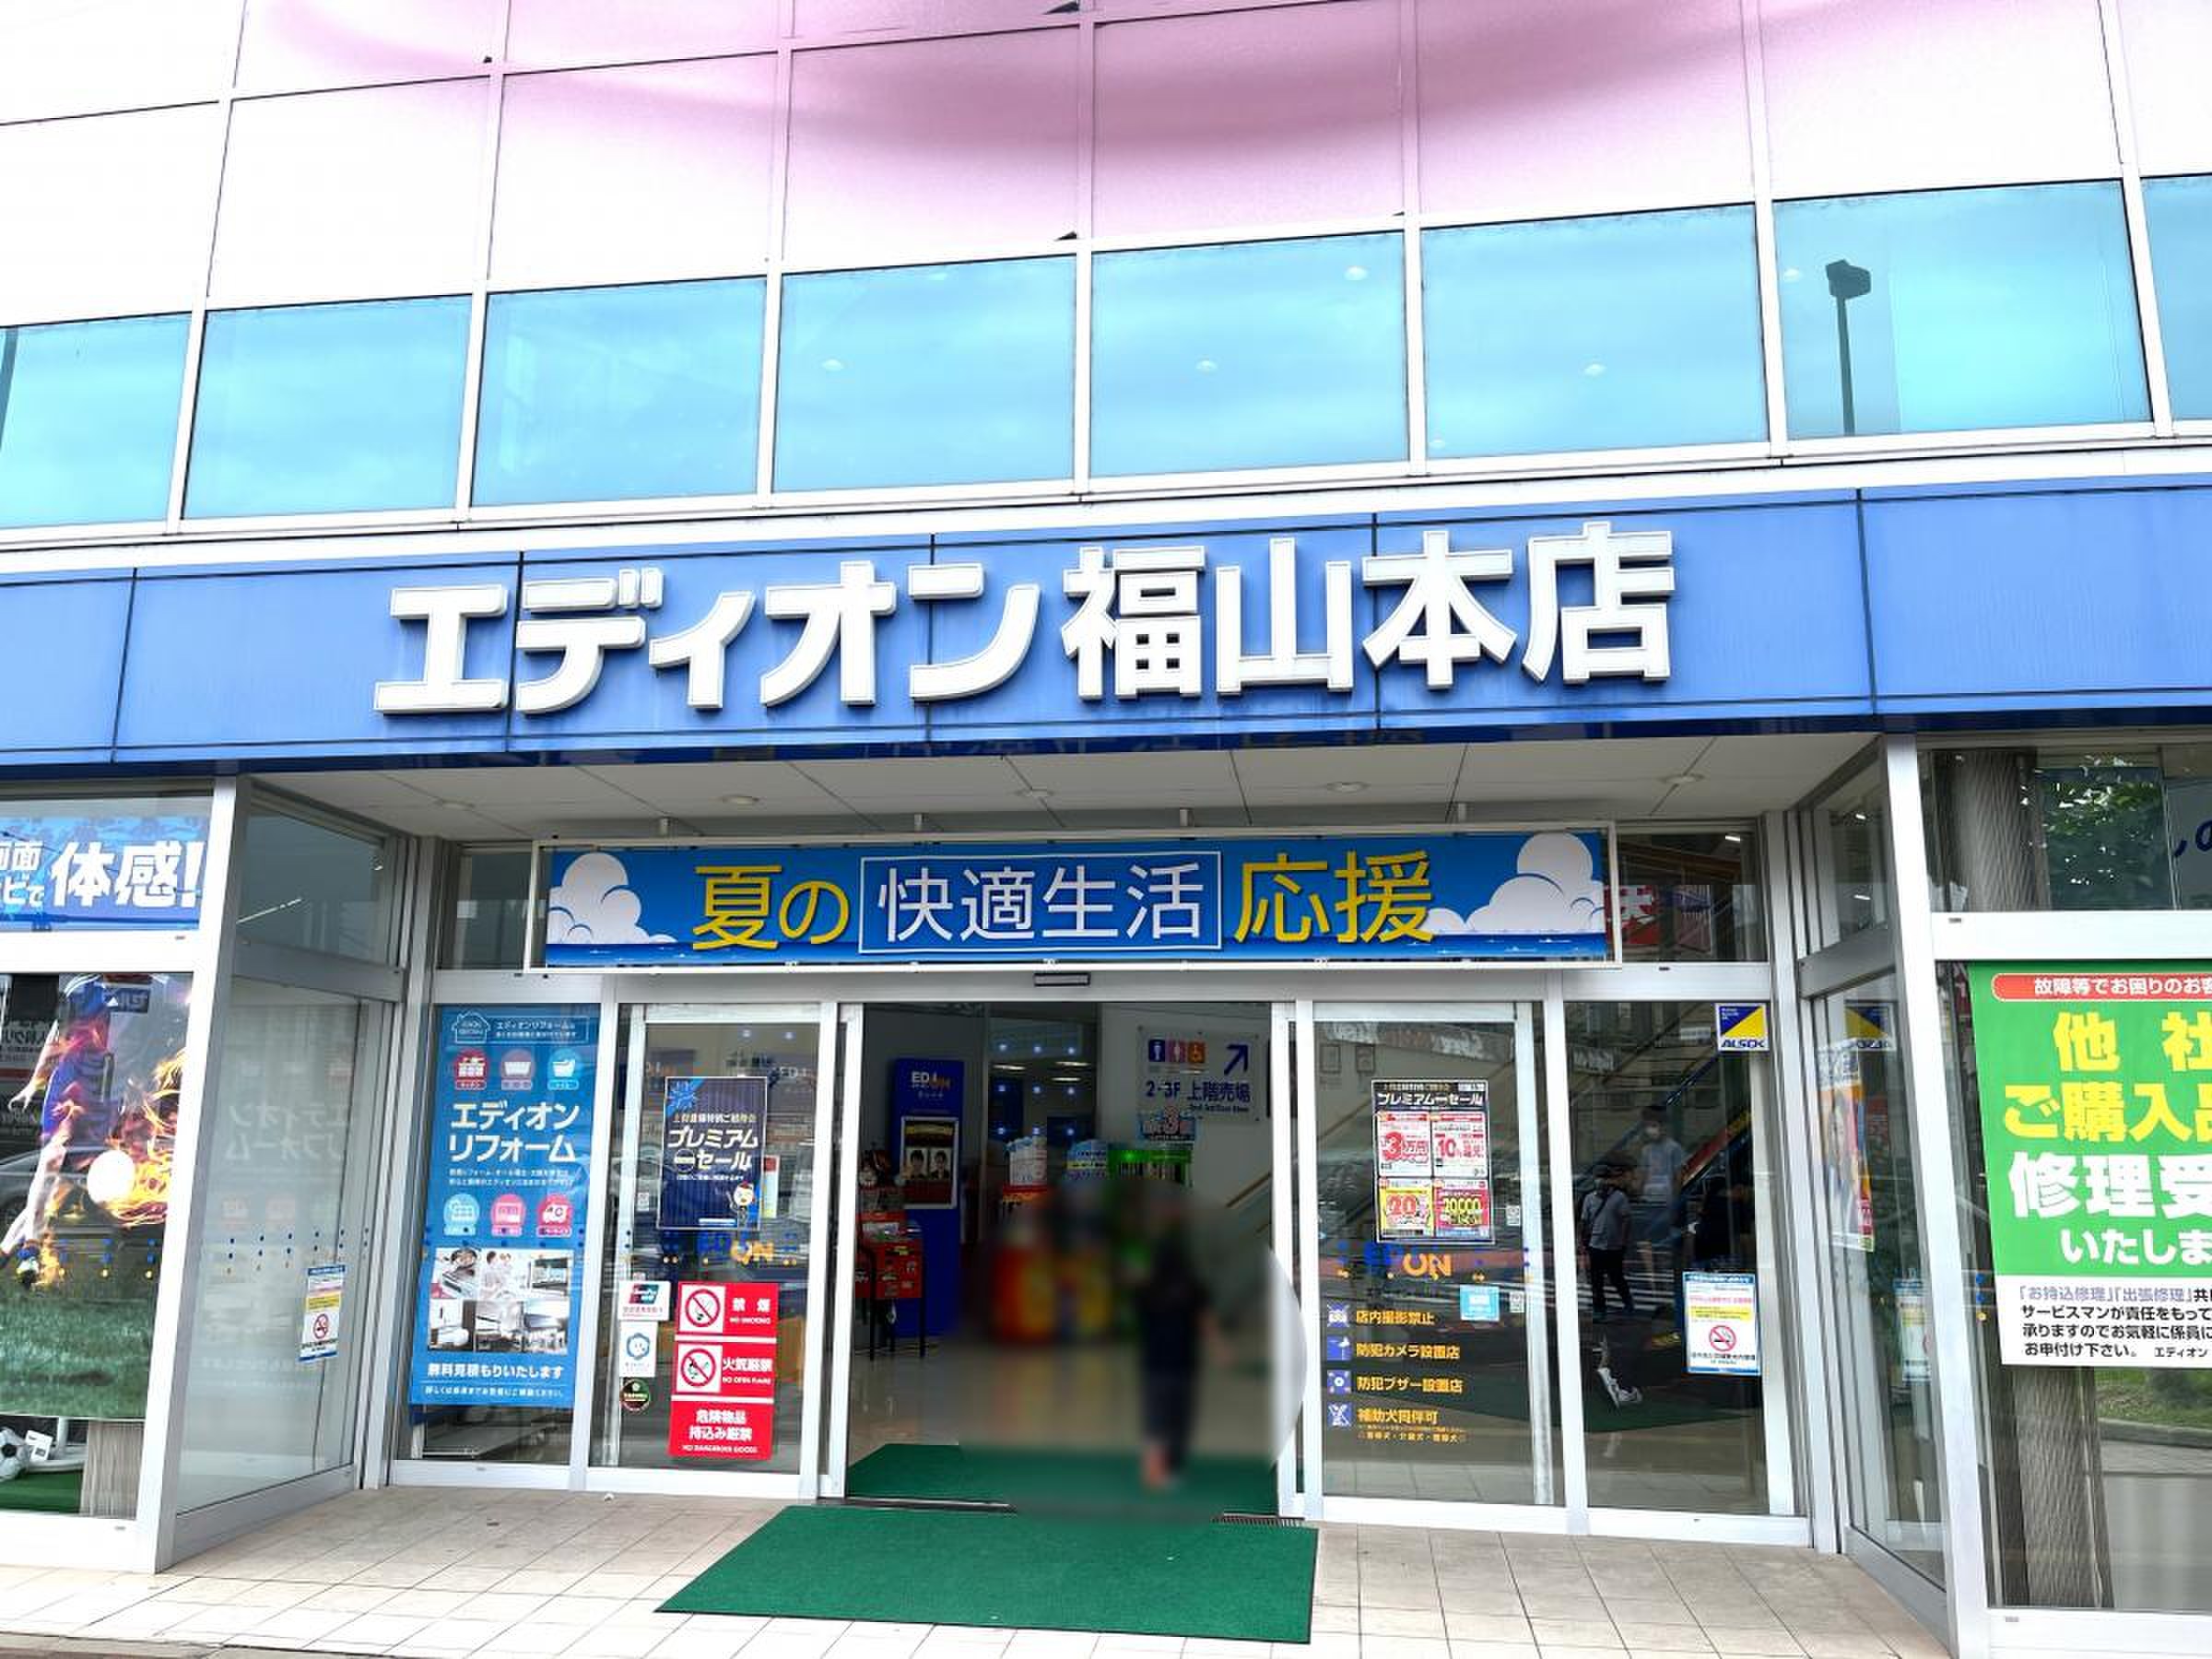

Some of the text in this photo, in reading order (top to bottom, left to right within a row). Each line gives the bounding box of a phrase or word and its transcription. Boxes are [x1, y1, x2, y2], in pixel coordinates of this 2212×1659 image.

[373, 520, 1677, 718] エディオン福山本店
[0, 874, 44, 908] ビで
[692, 850, 1435, 950] 夏の 快適生活 応援
[1721, 1039, 1765, 1048] ALSOK
[451, 1100, 580, 1131] エディオン
[2004, 1081, 2212, 1143] ご購入
[667, 1124, 759, 1148] プレミアム
[449, 1134, 576, 1162] リフォーム
[2007, 1151, 2212, 1219] 修理受
[2060, 1228, 2212, 1265] いたしま
[2019, 1285, 2212, 1302] 「お持込修理」「出張修理」共
[1356, 1310, 1435, 1325] 店内撮影禁止
[2021, 1304, 2212, 1322] サービスマンが責任をもって
[2022, 1324, 2212, 1340] 承りますのでお気軽に係員に
[1356, 1342, 1461, 1359] 防犯カメラ設置店
[2025, 1342, 2207, 1358] お申付け下さい。 エディオン
[722, 1358, 773, 1373] 火気厳禁
[1356, 1375, 1464, 1394] 防犯ブザー設置店
[1357, 1407, 1439, 1425] 補助犬同伴可
